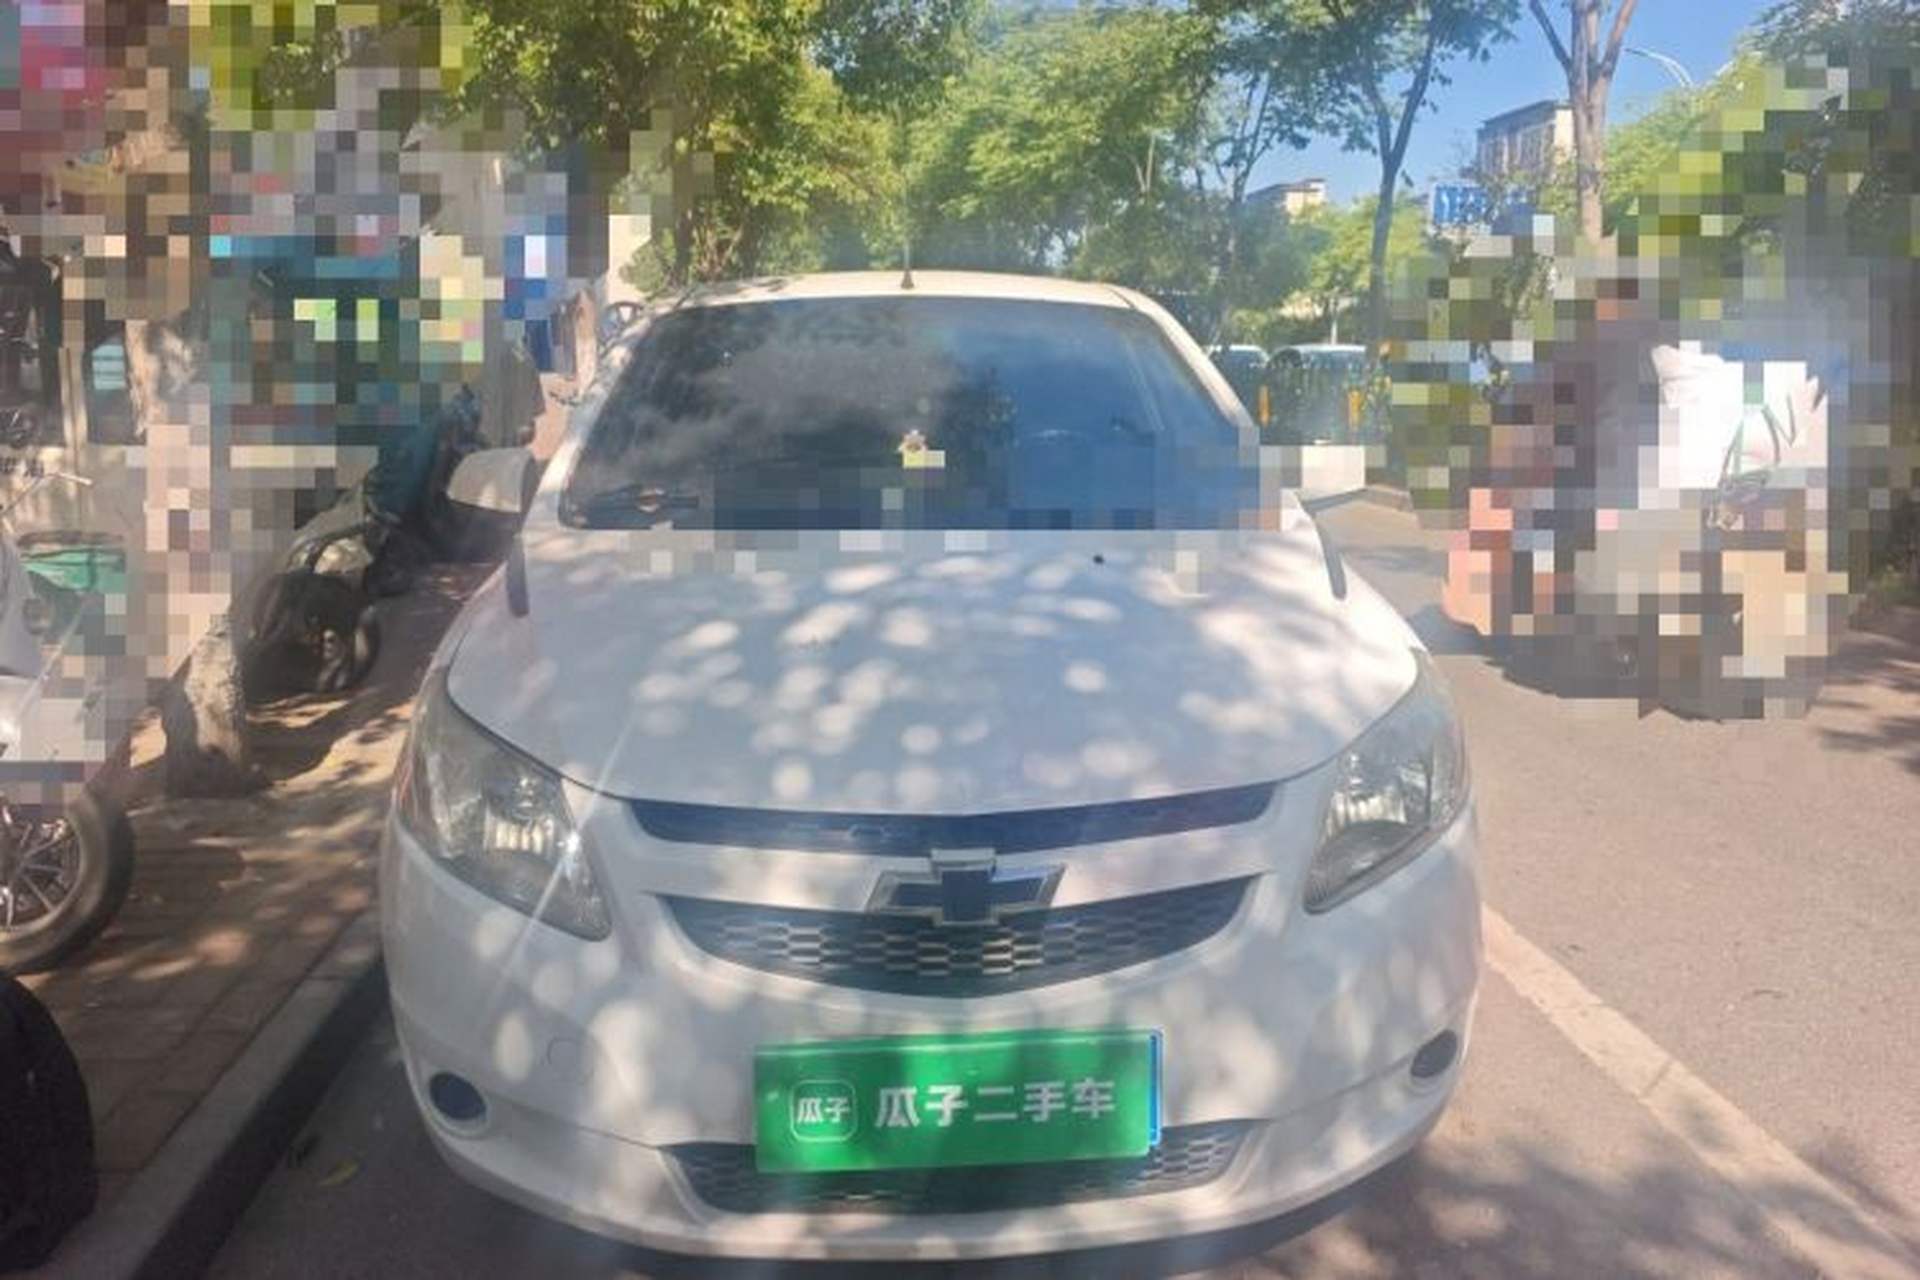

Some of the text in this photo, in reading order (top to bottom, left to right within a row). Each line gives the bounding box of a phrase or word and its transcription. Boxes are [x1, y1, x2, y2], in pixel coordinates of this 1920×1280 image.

[797, 1097, 850, 1123] 瓜子
[875, 1077, 1116, 1128] 瓜子二手车
